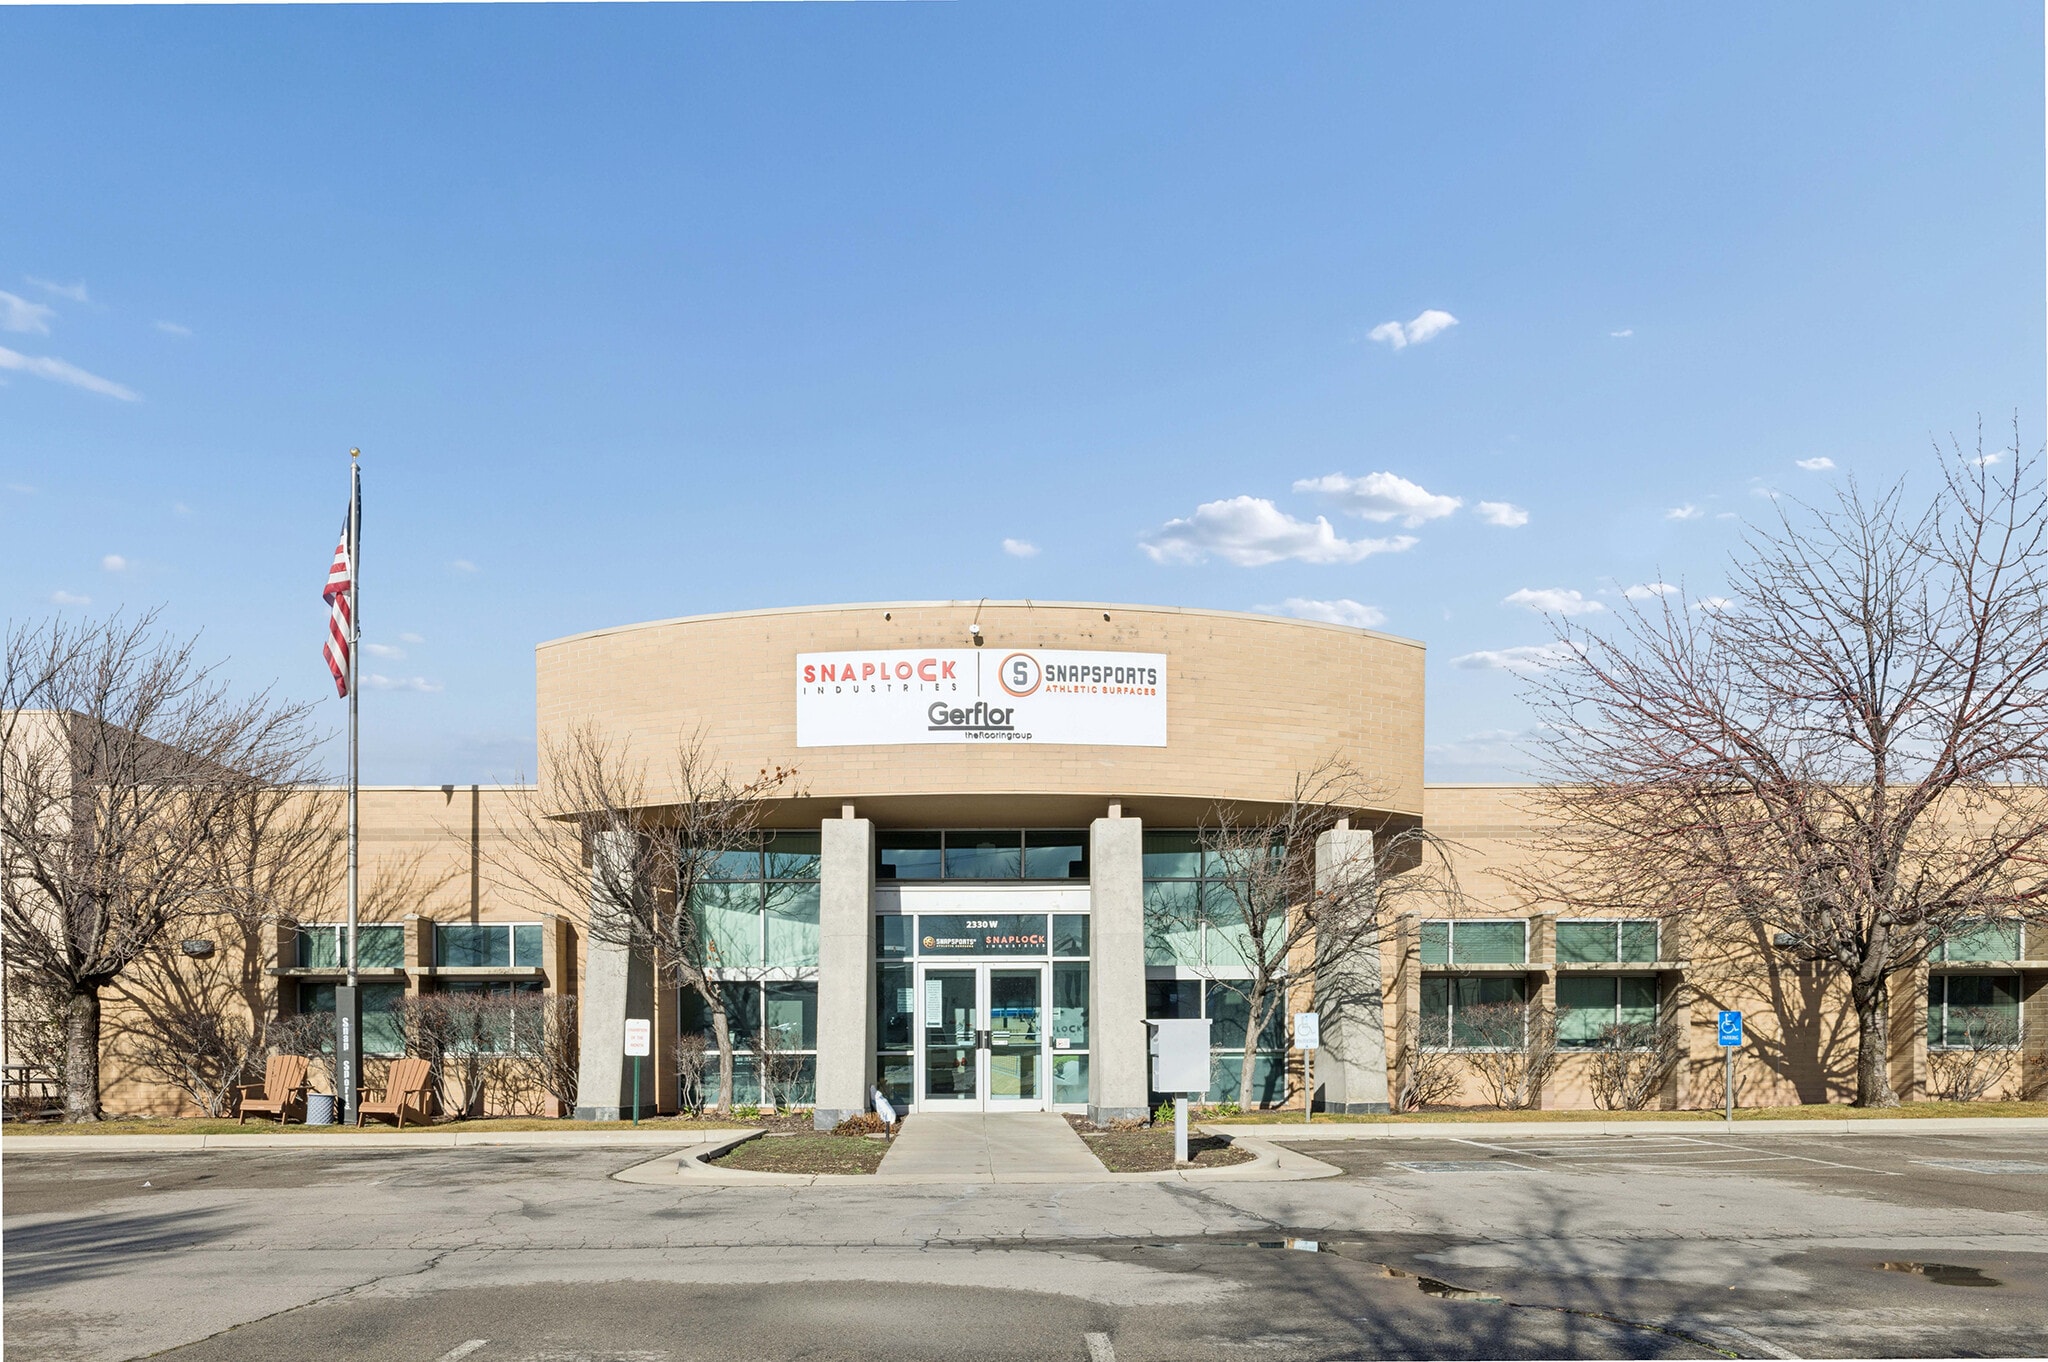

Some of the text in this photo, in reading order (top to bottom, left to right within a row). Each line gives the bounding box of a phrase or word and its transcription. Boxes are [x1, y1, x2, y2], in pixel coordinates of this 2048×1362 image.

[803, 658, 957, 683] SNAPLOCK
[1045, 665, 1157, 686] SNAPSPORTS
[803, 683, 957, 695] INDUSTRIES
[1045, 684, 1157, 696] ATHLETIC SURFACES
[928, 701, 1015, 727] Gerflor
[966, 920, 998, 928] 2330 W
[985, 934, 1046, 944] SNAPLOCK
[342, 1017, 350, 1051] Snap
